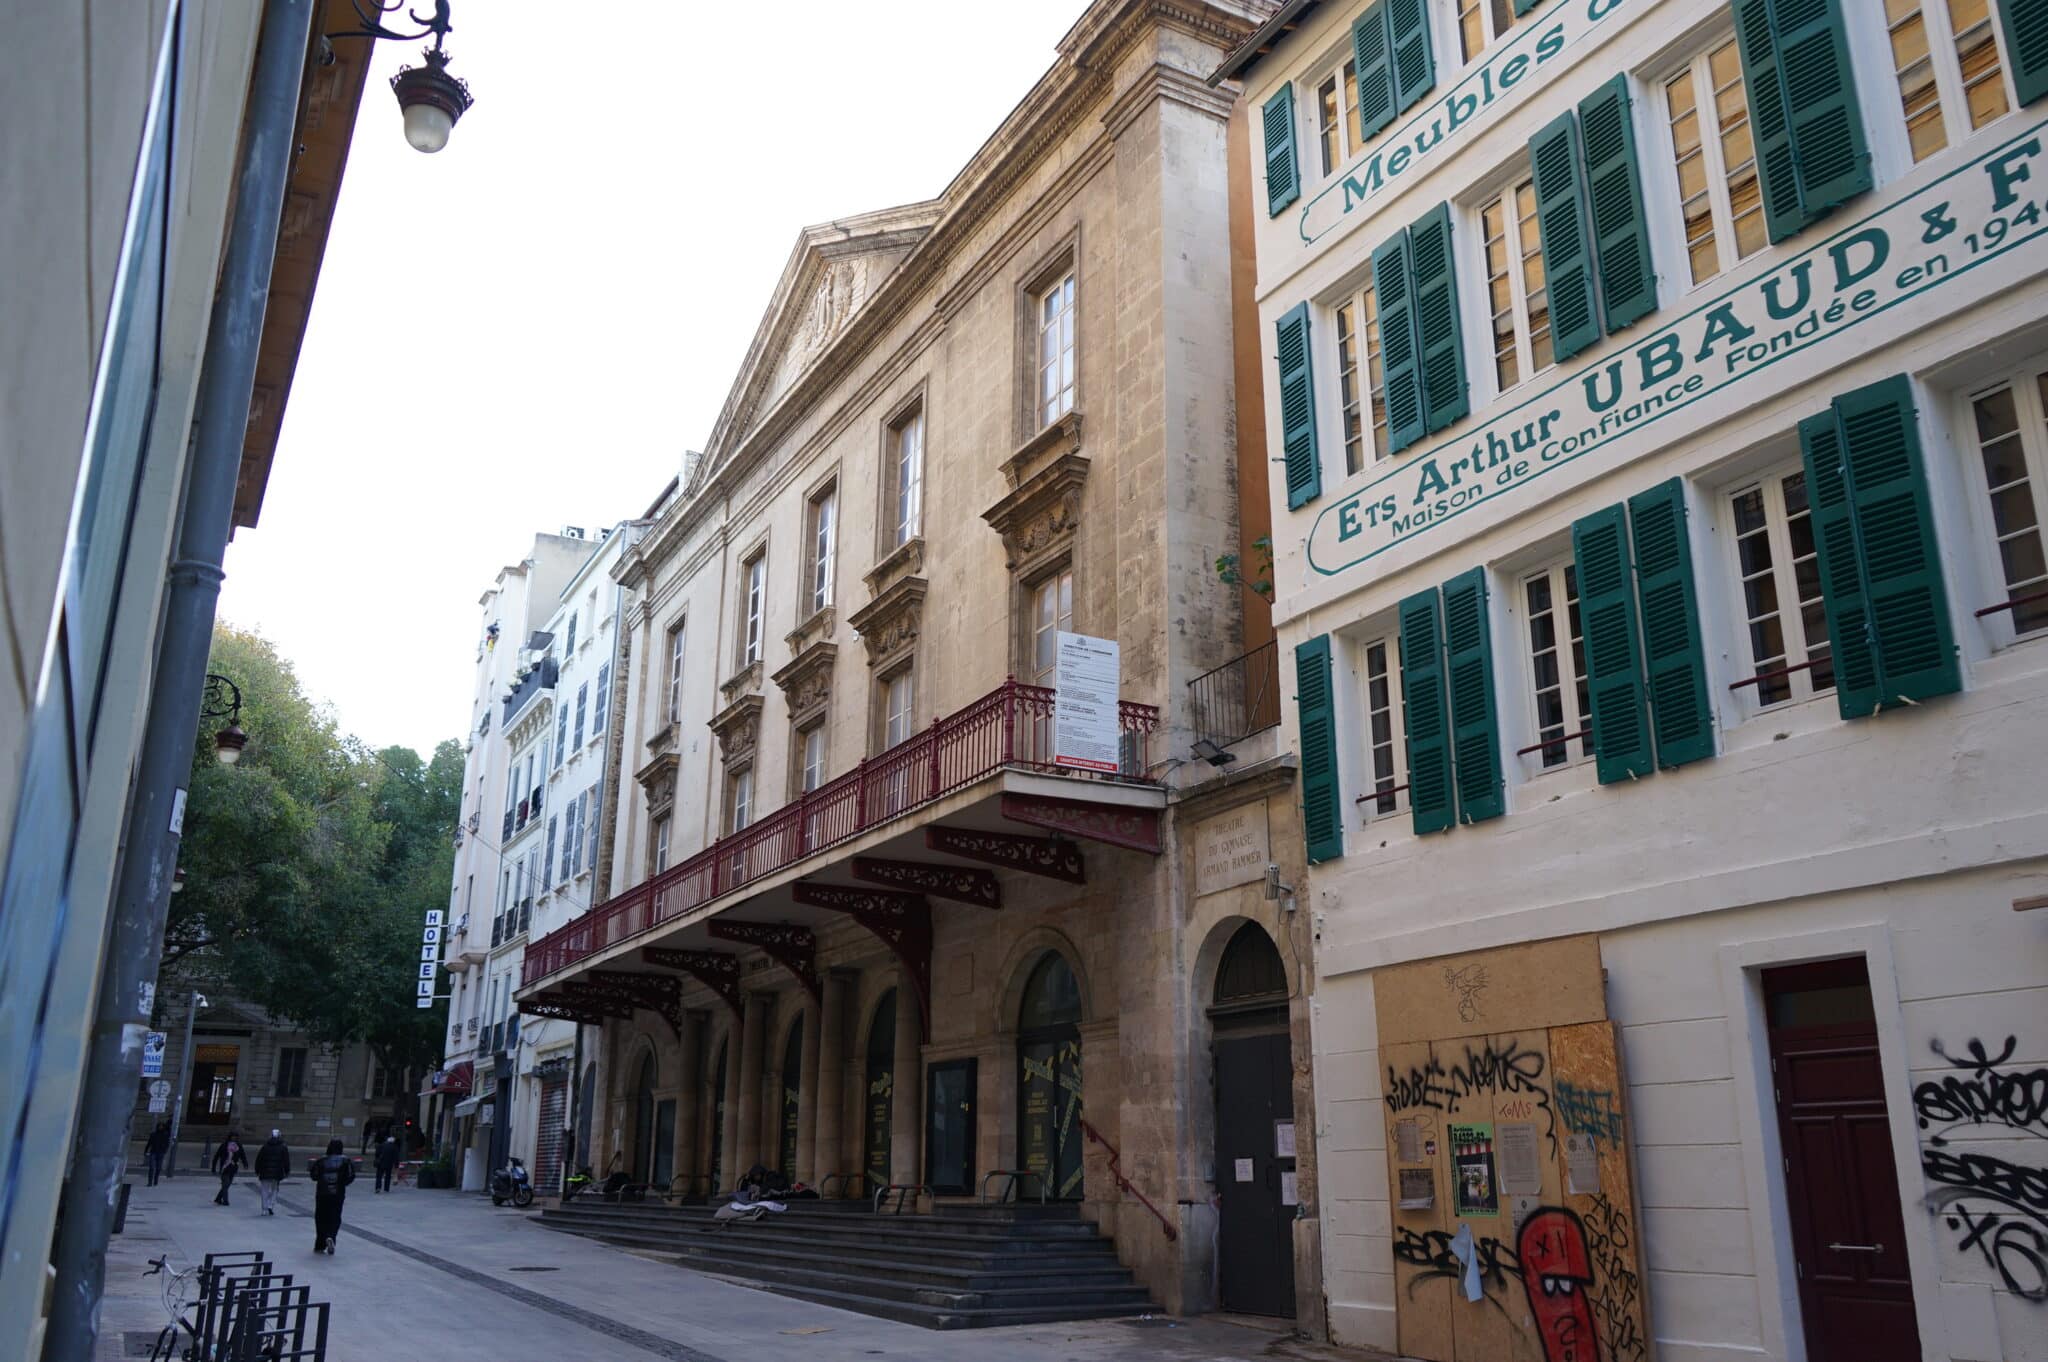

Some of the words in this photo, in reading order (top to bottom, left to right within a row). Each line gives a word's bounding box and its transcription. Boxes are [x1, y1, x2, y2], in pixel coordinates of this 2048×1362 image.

[1344, 22, 1564, 212] Meubles
[1391, 483, 1483, 538] Maison
[1496, 459, 1529, 486] de
[1541, 374, 1702, 461] Confiance
[1727, 288, 1876, 373] Fondée
[1895, 254, 1948, 289] en
[1964, 199, 2048, 254] 194
[1413, 409, 1561, 506] Arthur
[1583, 229, 1890, 412] UBAUD
[1920, 201, 1957, 244] &
[421, 912, 438, 994] HOTEL
